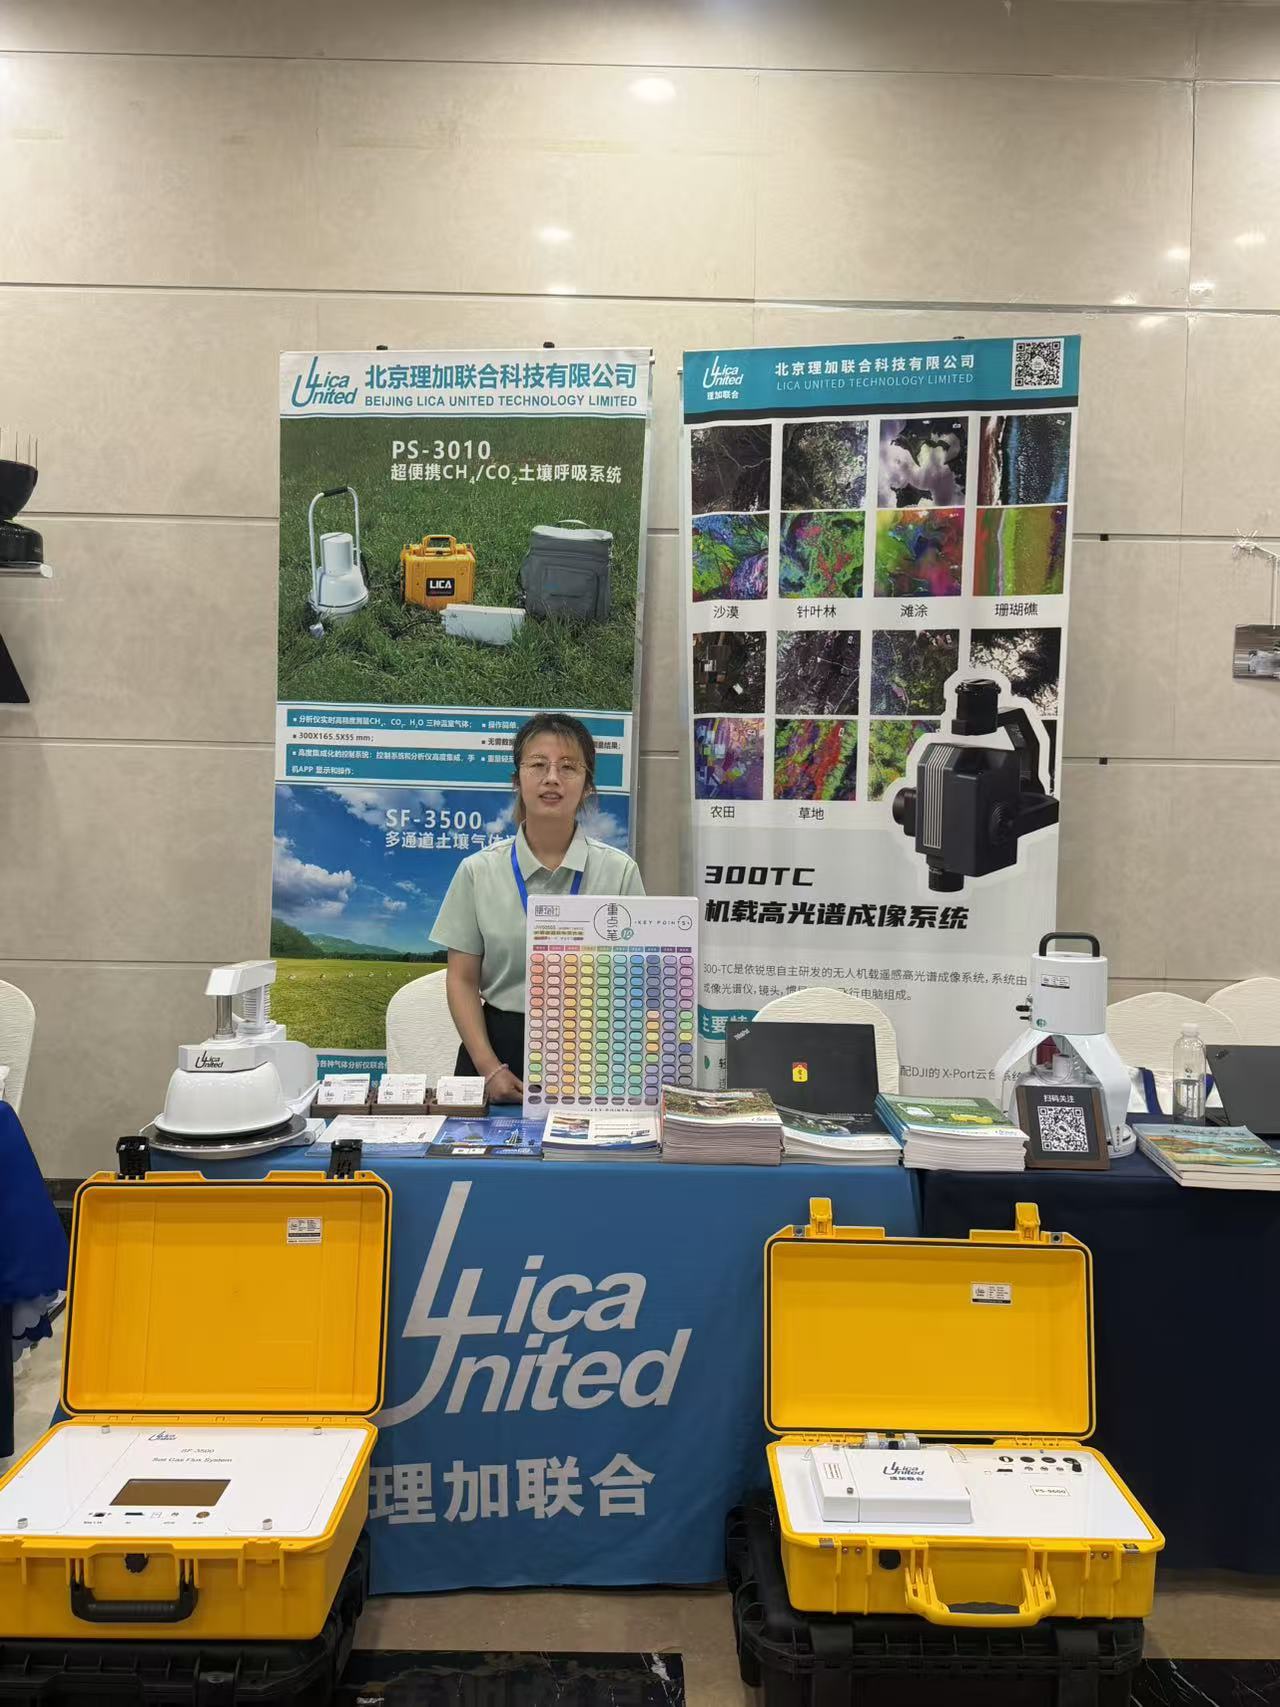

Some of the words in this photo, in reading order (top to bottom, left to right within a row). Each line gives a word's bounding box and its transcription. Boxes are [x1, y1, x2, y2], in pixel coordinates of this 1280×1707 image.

[774, 354, 976, 377] 北京理加联合科技有限公司
[364, 362, 637, 390] 北京理加联合科技有限公司
[776, 381, 801, 391] LICA
[804, 379, 846, 390] UNITED
[849, 377, 925, 388] TECHNOLOGY
[928, 373, 974, 384] LIMITED
[291, 374, 358, 407] United
[364, 395, 413, 407] BEIJING
[416, 395, 446, 407] LICA
[449, 395, 495, 407] UNITED
[498, 395, 584, 407] TECHNOLOGY
[588, 395, 637, 407] LIMITED
[391, 440, 491, 460] PS-3010
[429, 580, 452, 589] LICA
[712, 605, 740, 619] 沙漠
[796, 604, 837, 619] 针叶林
[900, 604, 928, 618] 滩涂
[994, 602, 1038, 617] 珊瑚礁
[385, 809, 482, 829] SF-3500
[709, 805, 736, 820] 农田
[797, 806, 825, 821] 草地
[704, 865, 815, 886] 300TC
[704, 899, 970, 930] 机载高光谱成像系统
[369, 1453, 656, 1525] 理加联合
